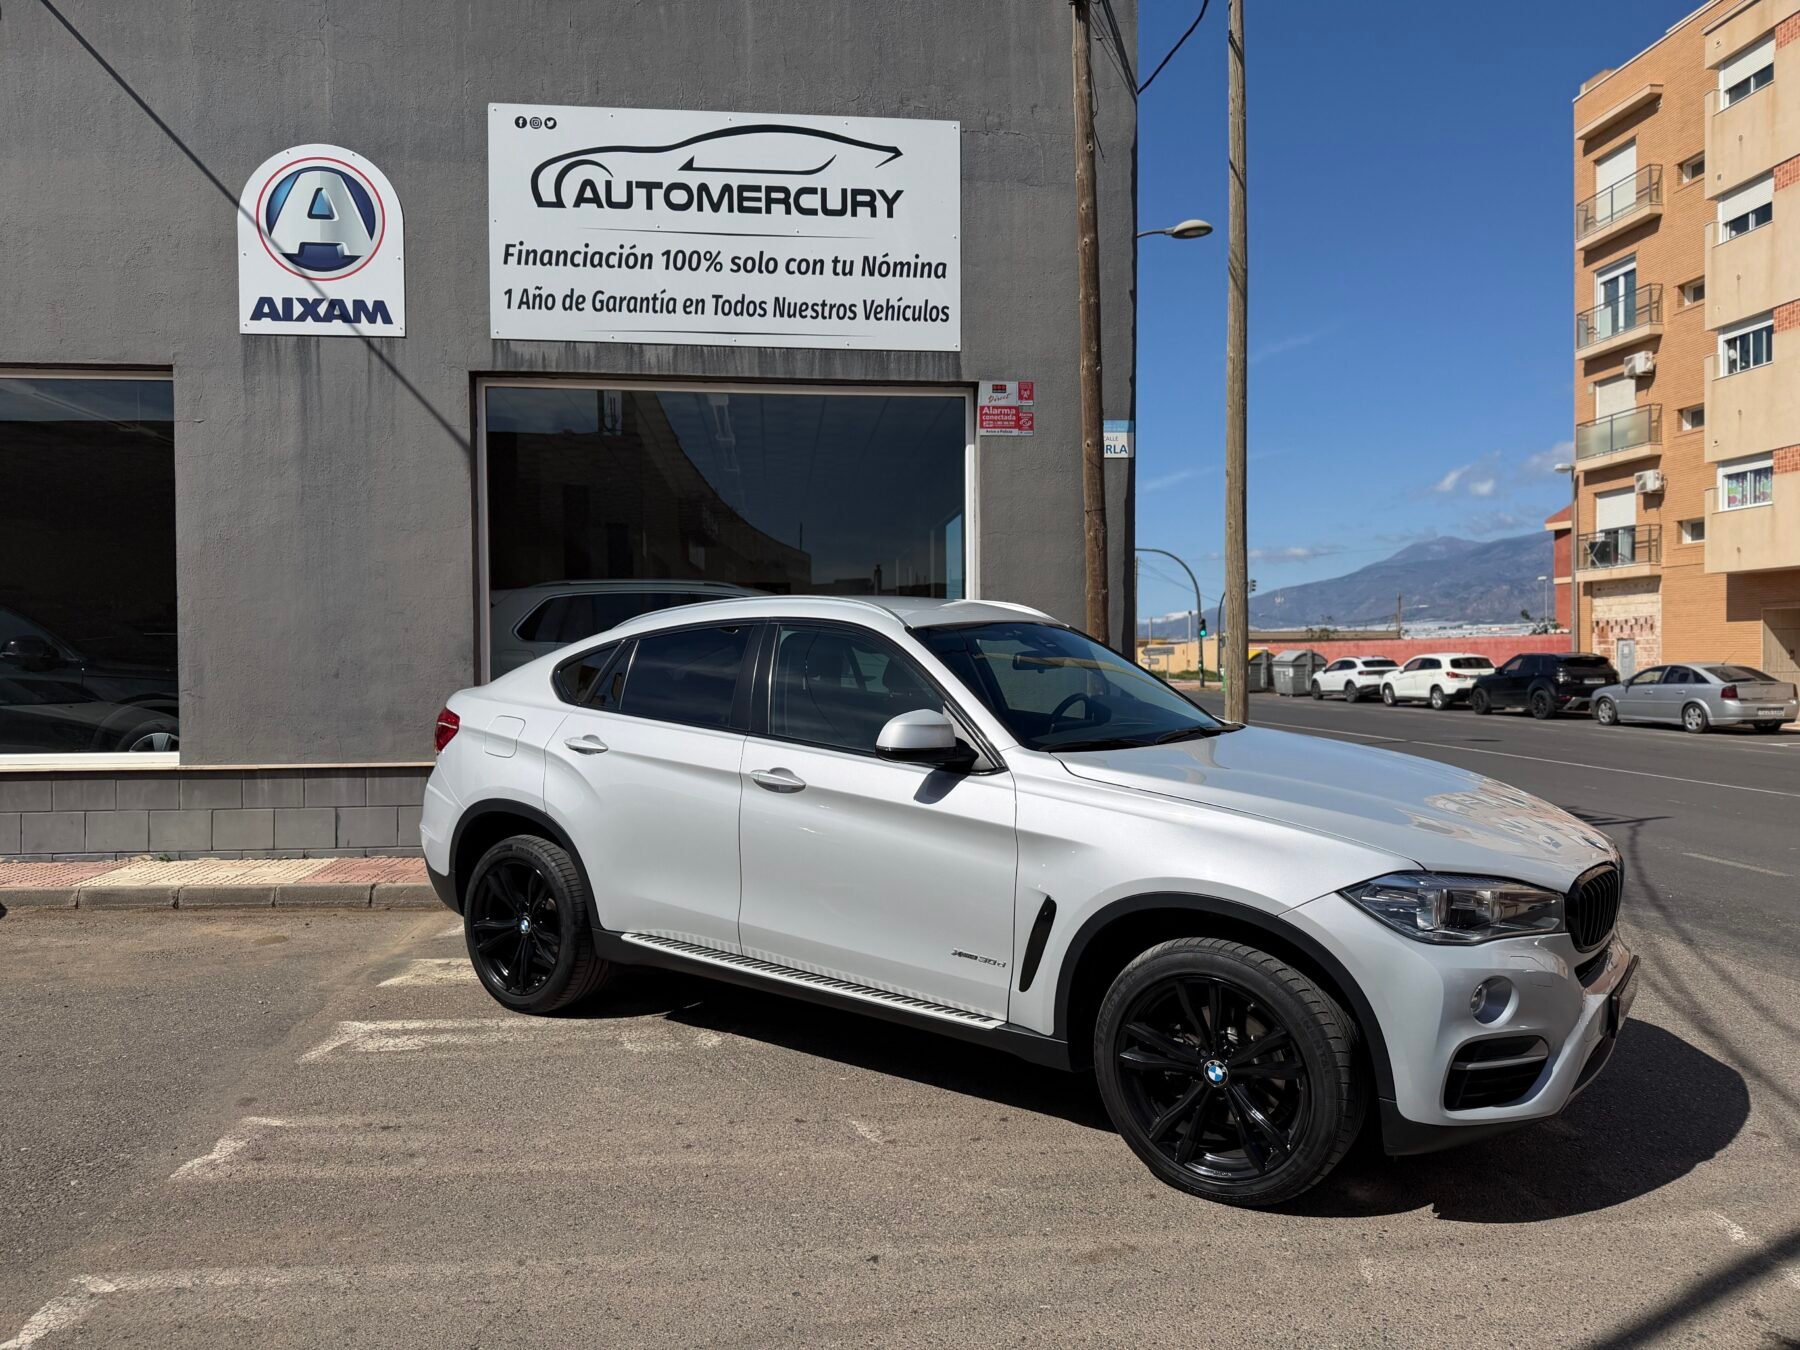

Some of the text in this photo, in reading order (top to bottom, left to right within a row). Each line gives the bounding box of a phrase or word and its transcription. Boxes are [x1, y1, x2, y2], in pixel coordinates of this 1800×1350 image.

[572, 178, 905, 219] AUTOMERCURY
[503, 240, 948, 280] Financiación 100% solo con tu Nómina
[249, 296, 394, 325] AIXAM
[504, 285, 951, 324] 1 Año de Garantía en Todos Nuestros Vehículos
[982, 406, 1016, 415] Alarma
[1104, 444, 1128, 454] RLA
